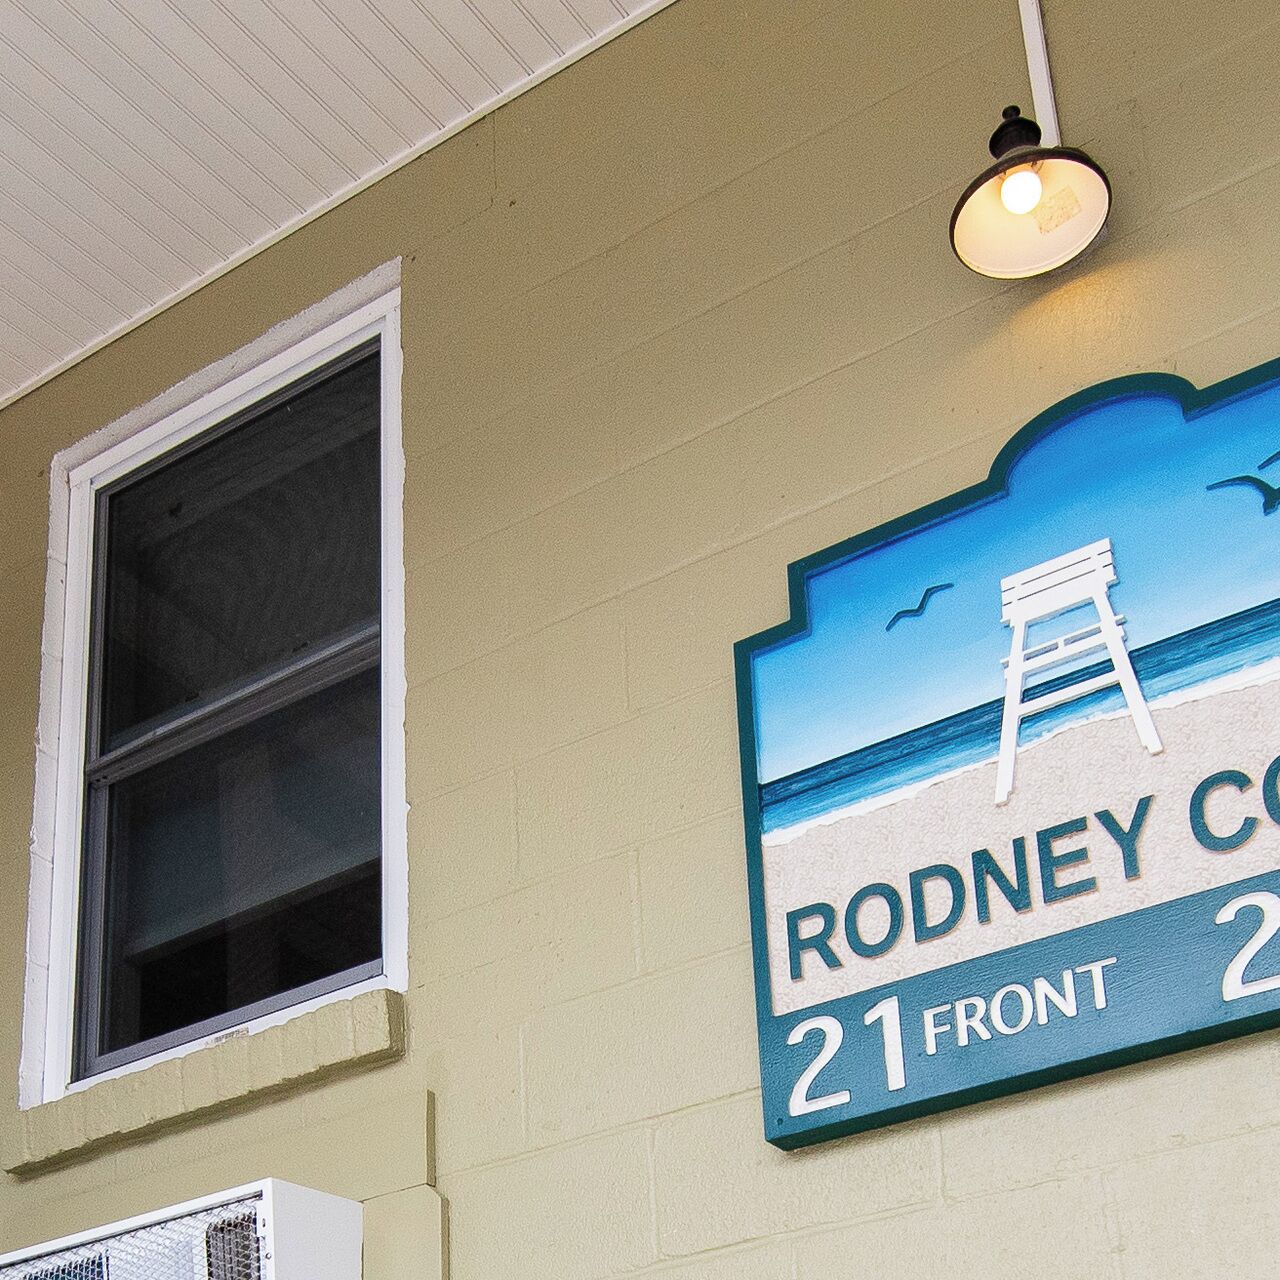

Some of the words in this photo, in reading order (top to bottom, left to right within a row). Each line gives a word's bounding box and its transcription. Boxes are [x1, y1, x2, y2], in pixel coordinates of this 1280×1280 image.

[787, 795, 1152, 981] RODNEY
[786, 996, 909, 1117] 21
[925, 958, 1117, 1055] FRONT
